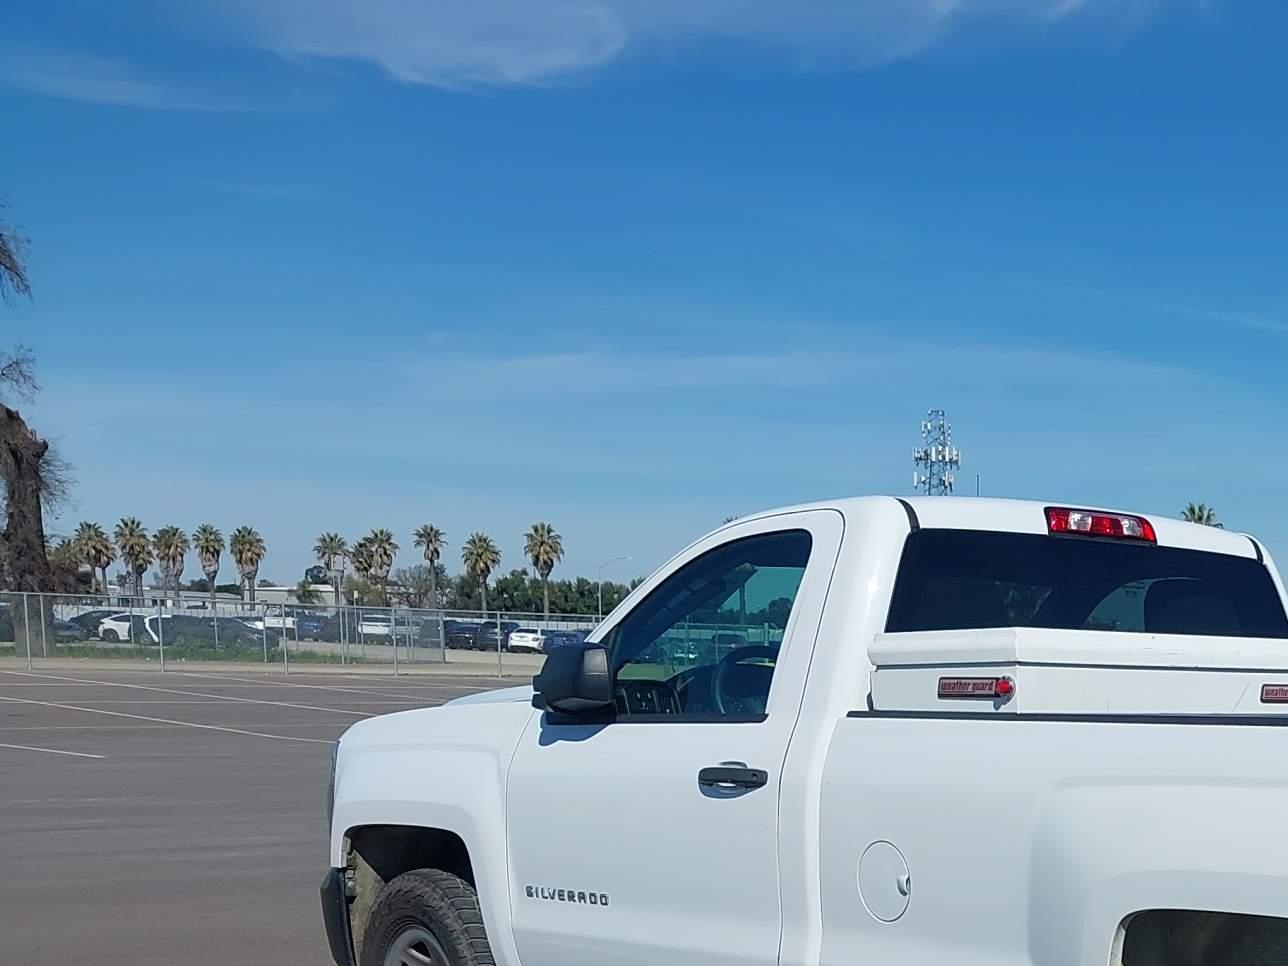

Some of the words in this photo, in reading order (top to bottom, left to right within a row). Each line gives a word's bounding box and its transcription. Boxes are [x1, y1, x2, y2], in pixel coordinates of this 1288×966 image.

[941, 680, 970, 691] weather
[971, 680, 994, 693] guard
[525, 885, 609, 906] SILVERADO
